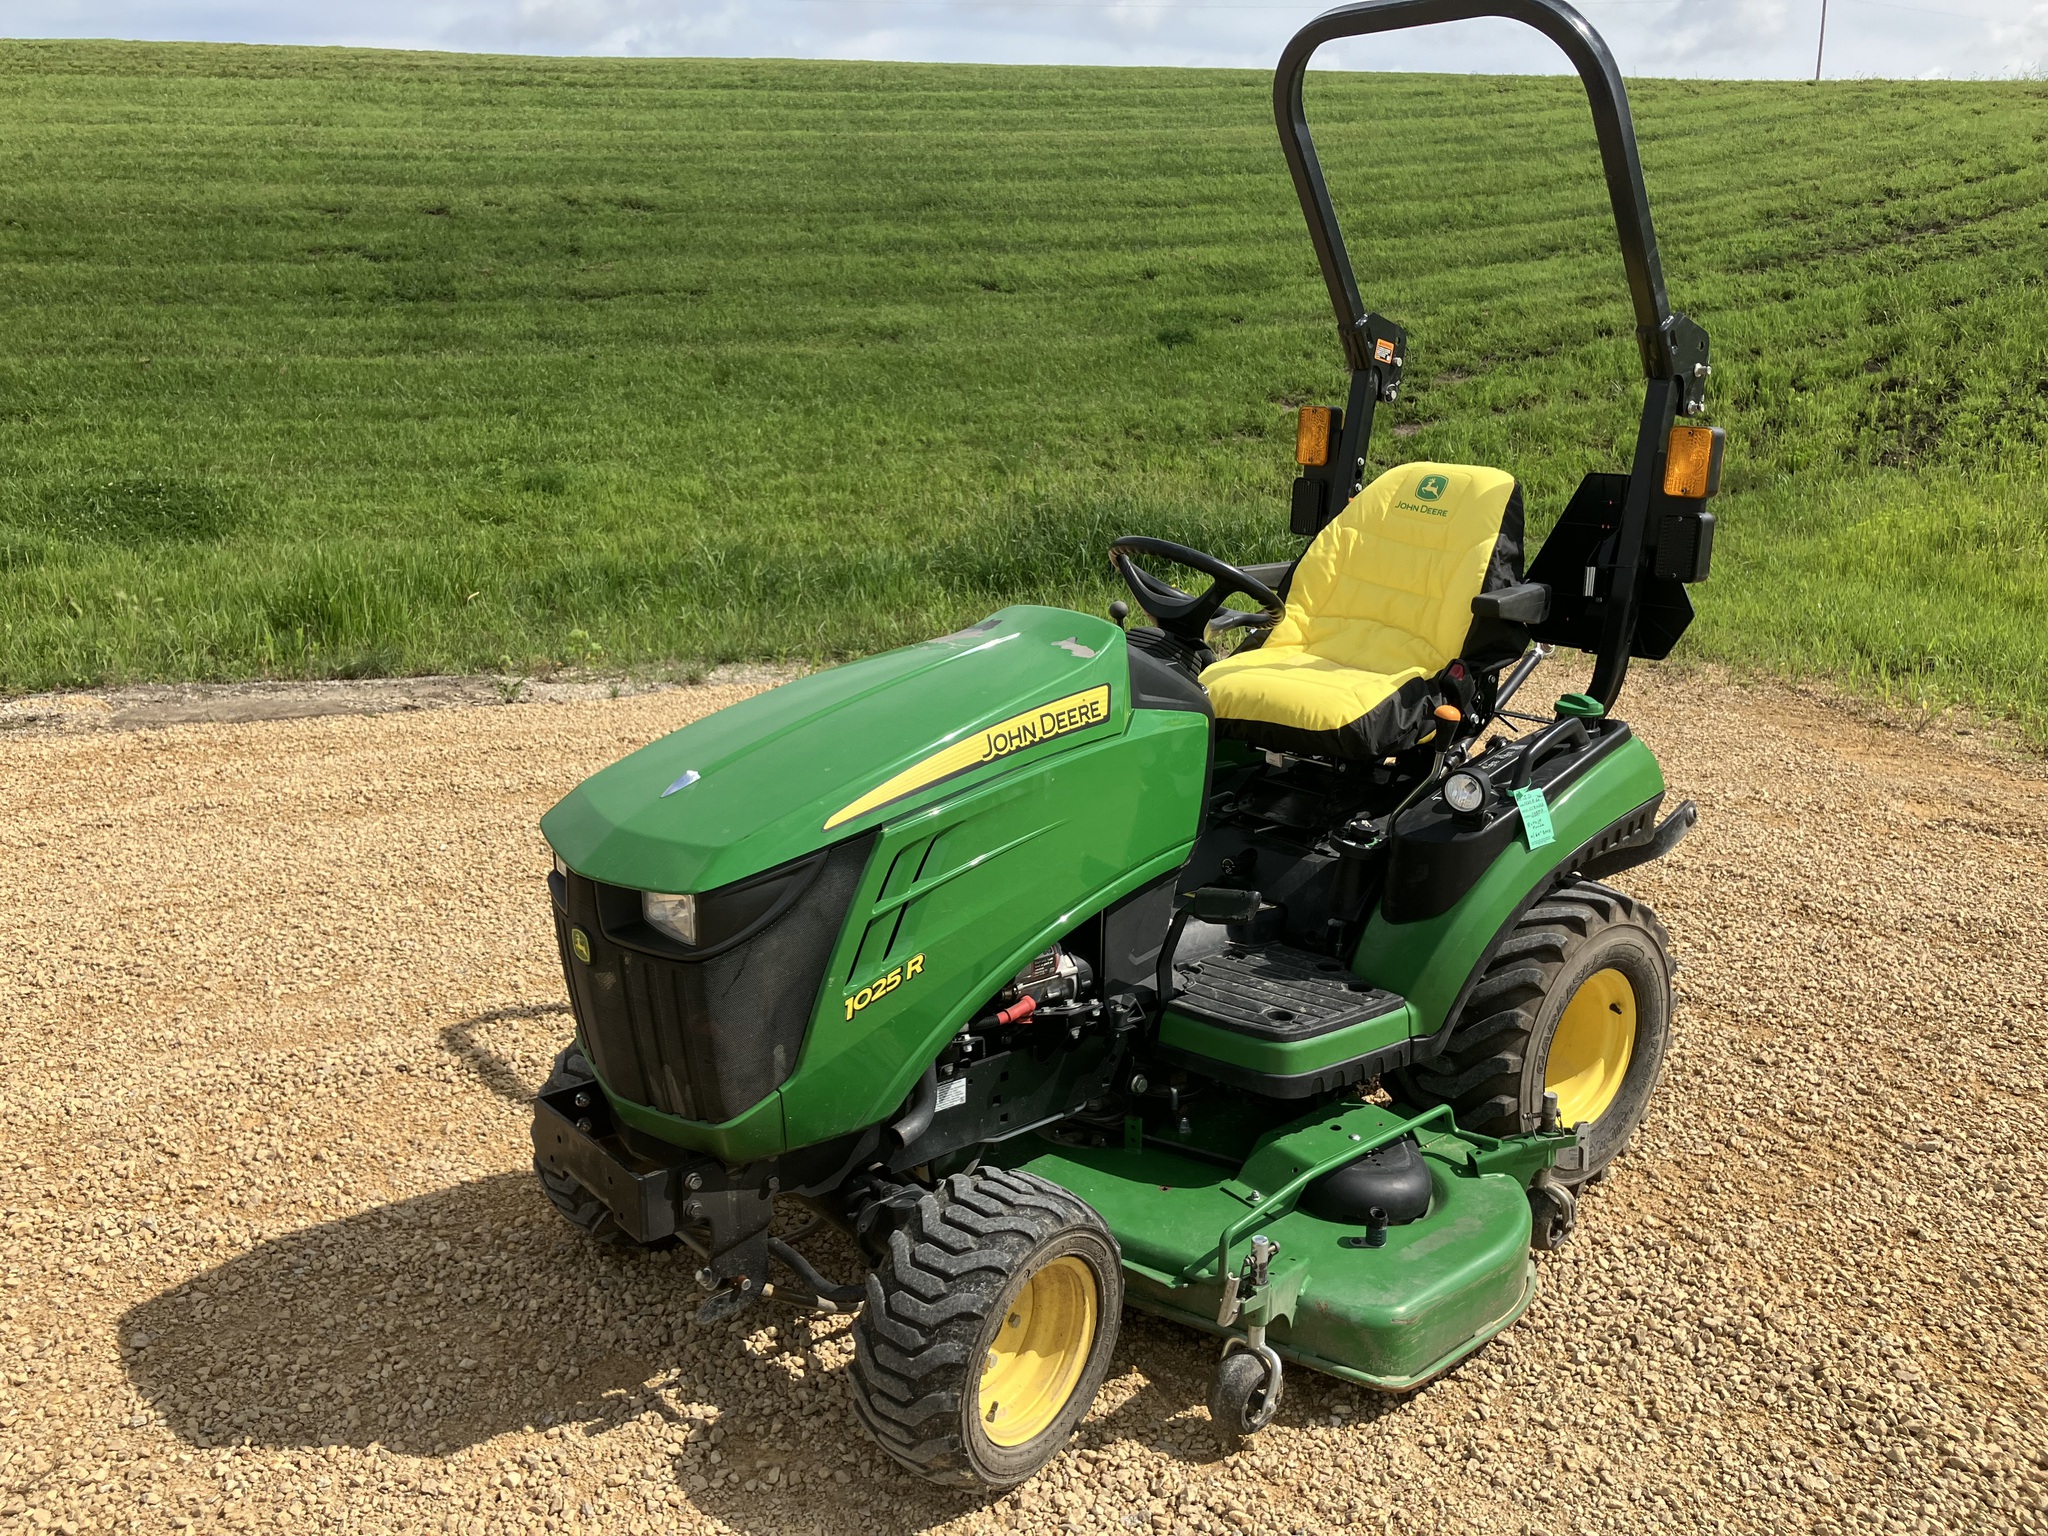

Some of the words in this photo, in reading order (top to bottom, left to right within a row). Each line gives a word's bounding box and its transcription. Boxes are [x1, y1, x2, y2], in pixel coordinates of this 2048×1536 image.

[1395, 501, 1419, 512] JOHN
[1420, 504, 1448, 517] DEERE
[982, 721, 1037, 759] JOHN
[1040, 700, 1101, 735] DEERE
[844, 966, 902, 1021] 1025
[906, 953, 925, 981] R
